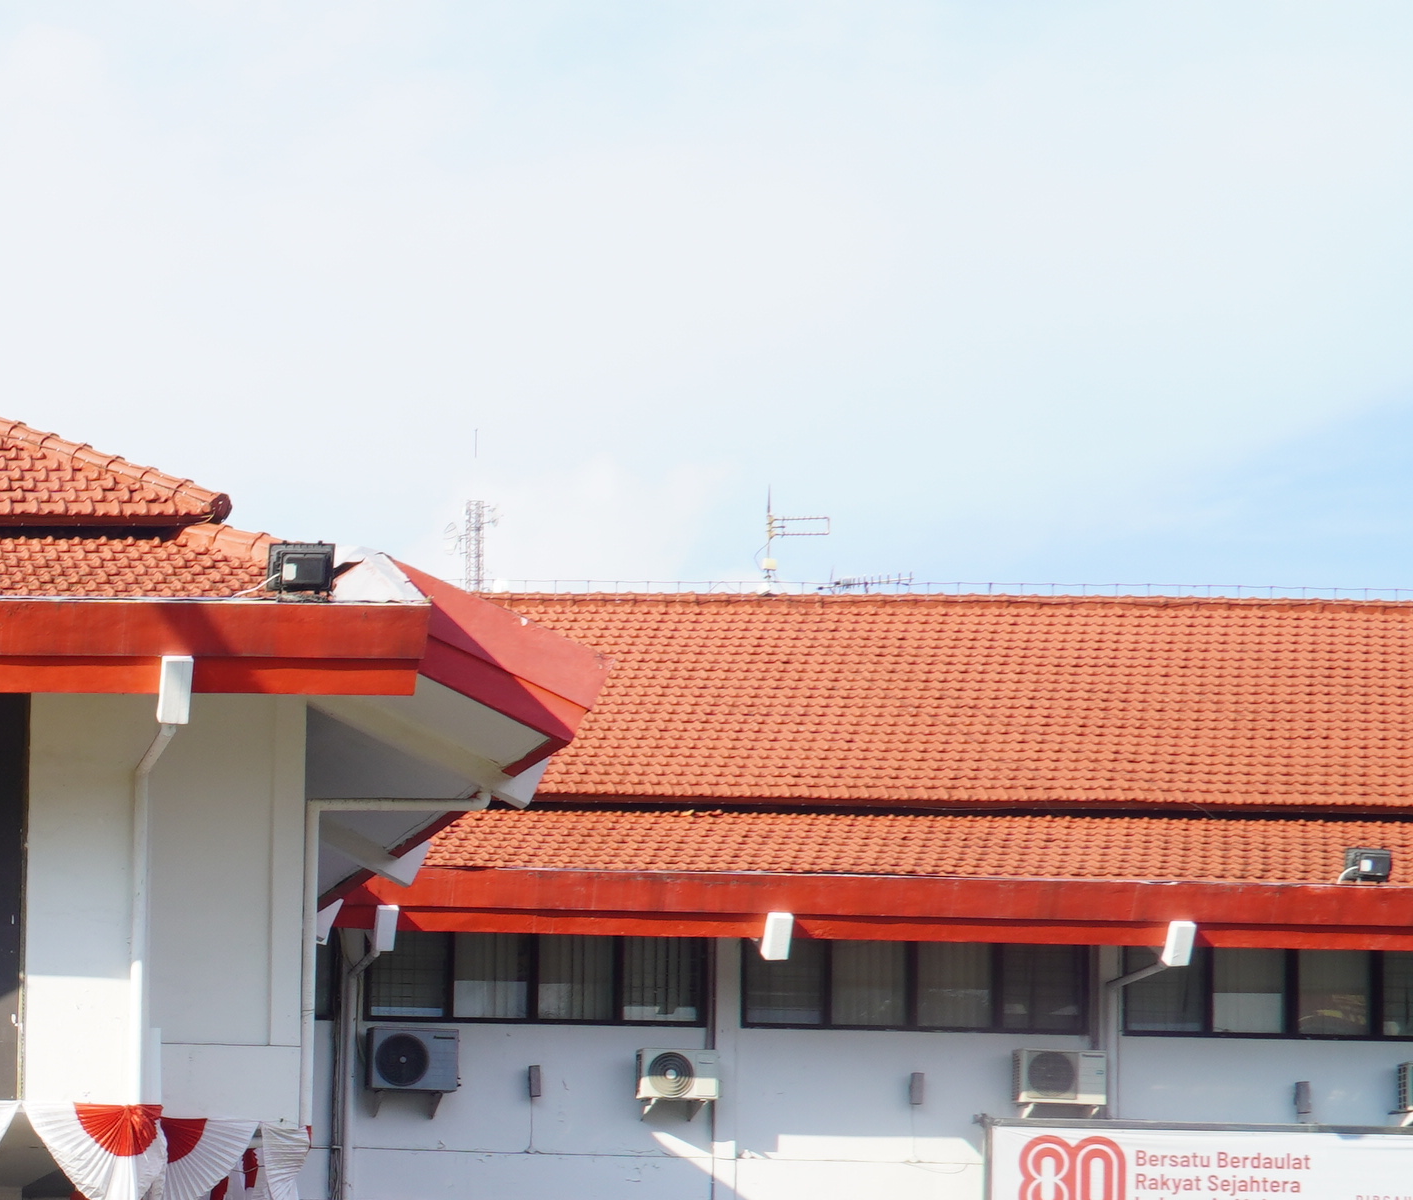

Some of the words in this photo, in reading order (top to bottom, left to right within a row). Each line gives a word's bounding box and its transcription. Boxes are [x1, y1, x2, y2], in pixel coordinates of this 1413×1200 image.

[1135, 1149, 1211, 1168] Bersatu
[1216, 1151, 1311, 1170] Berdaulat
[1135, 1173, 1202, 1195] Rakyat
[1207, 1174, 1302, 1196] Sejahtera
